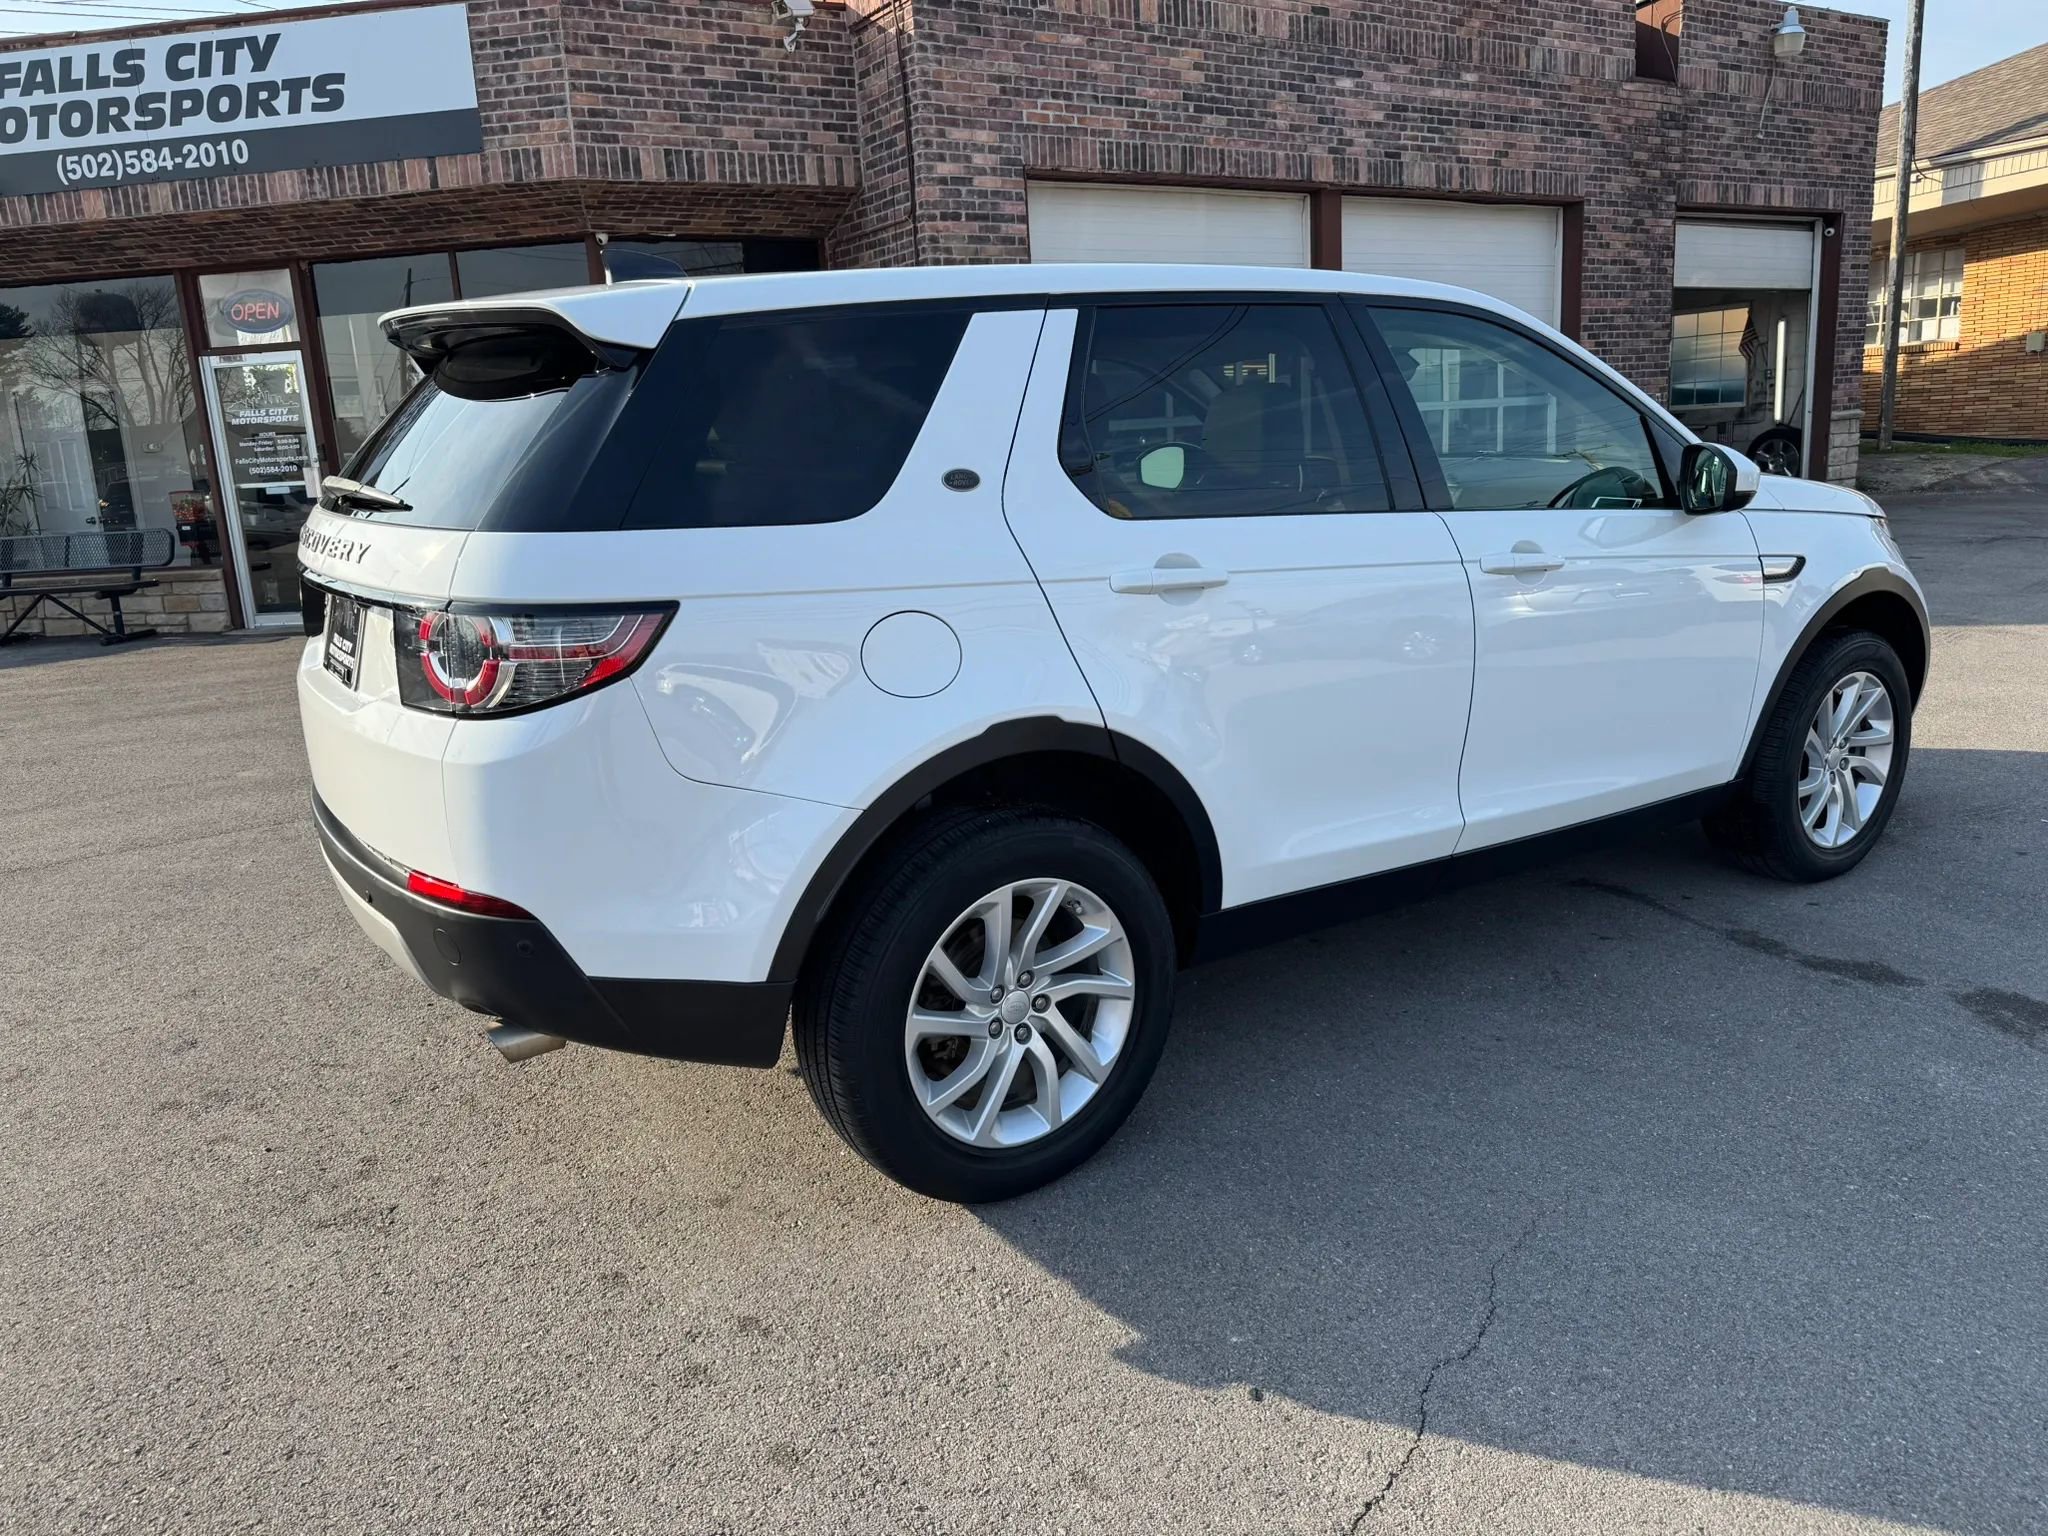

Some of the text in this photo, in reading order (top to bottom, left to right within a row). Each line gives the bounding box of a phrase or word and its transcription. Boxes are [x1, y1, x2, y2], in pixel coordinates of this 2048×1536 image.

[0, 33, 282, 99] FALLS CITY
[0, 72, 346, 145] OTORSPORTS
[56, 138, 249, 185] (502)584-2010
[230, 301, 281, 321] OPEN
[232, 414, 299, 425] MOTORSPORTS
[240, 408, 288, 418] FALLS CITY
[248, 465, 298, 475] (502)584-2010
